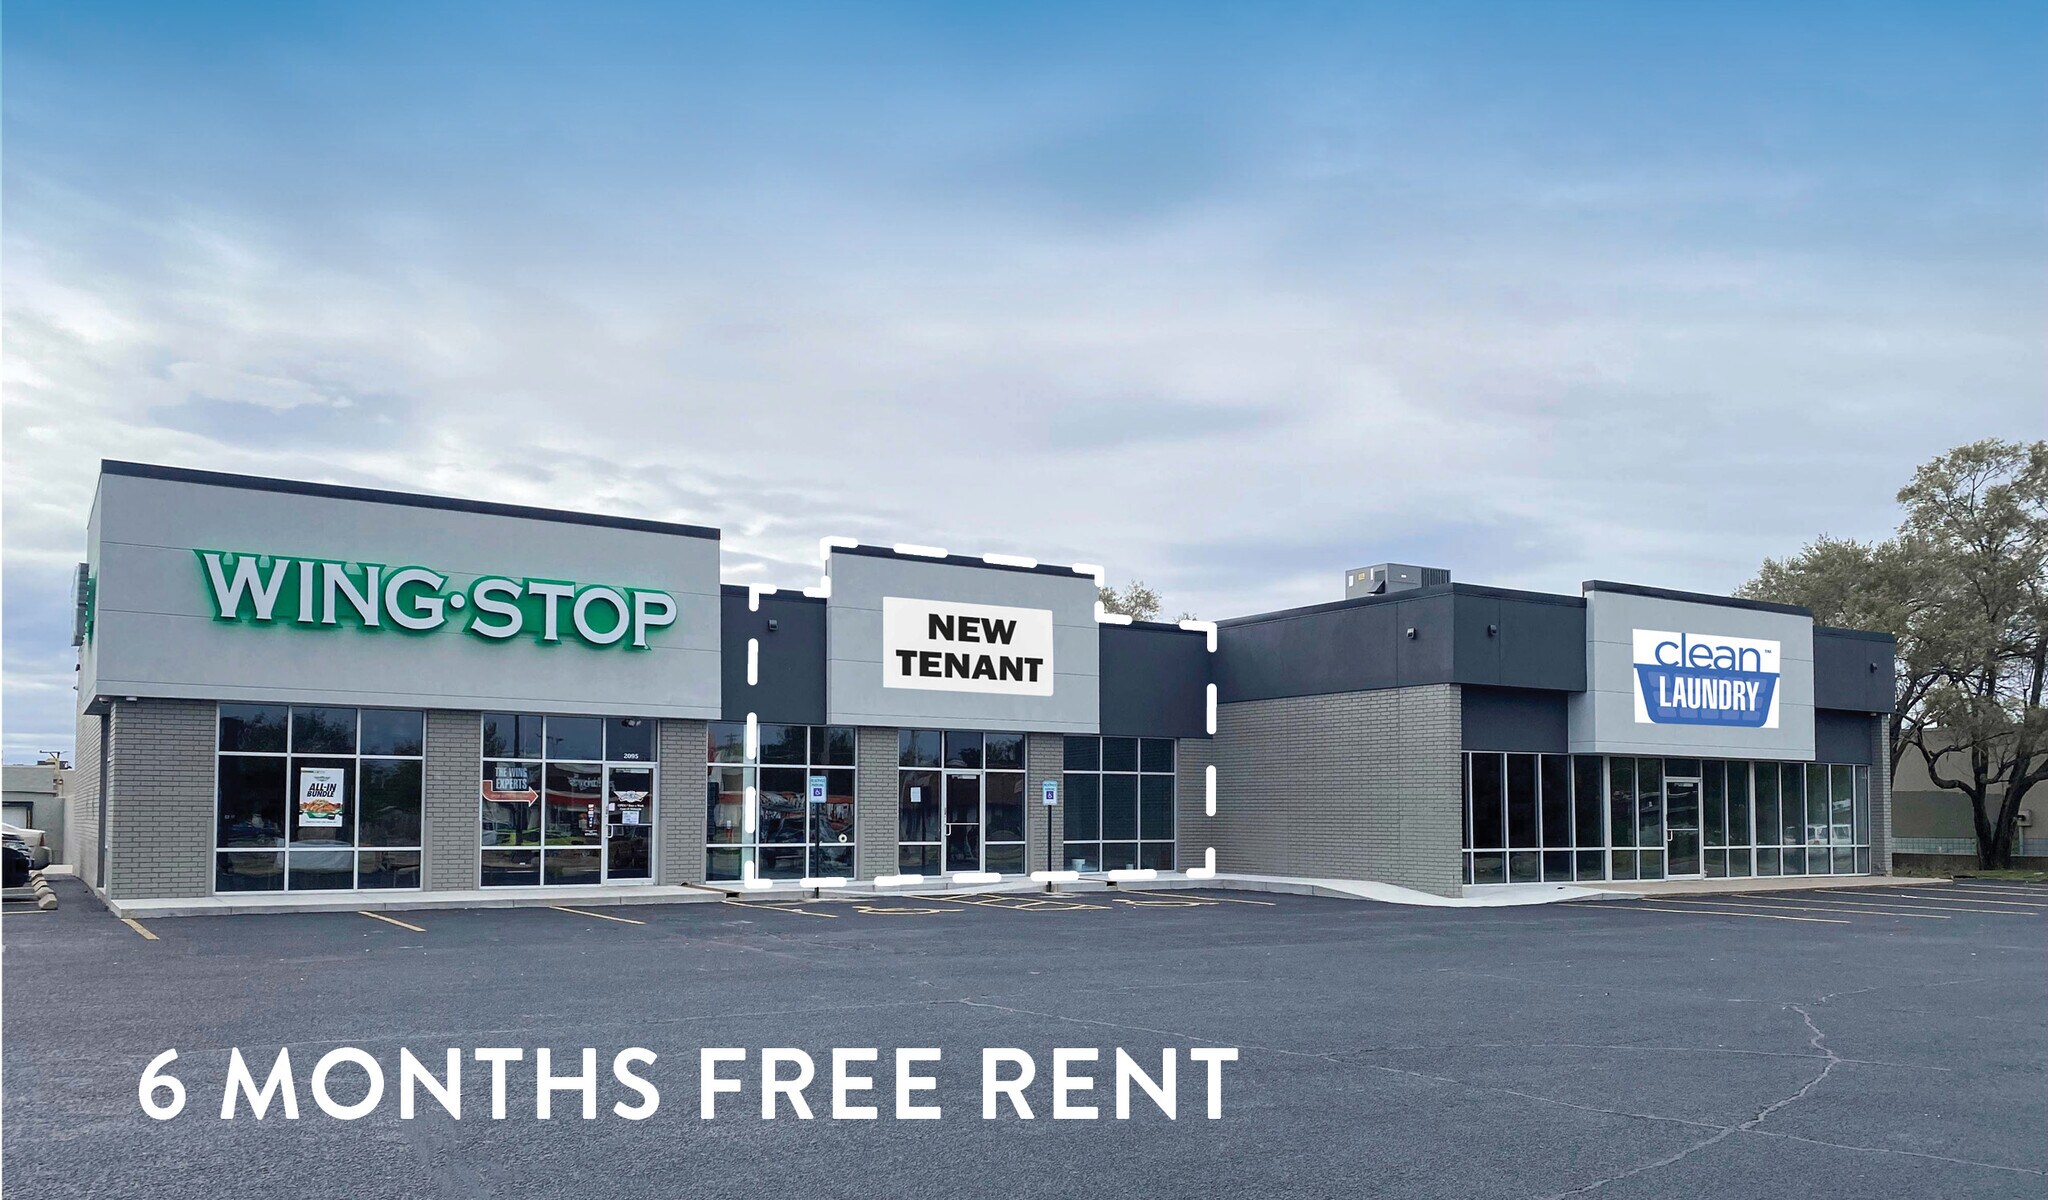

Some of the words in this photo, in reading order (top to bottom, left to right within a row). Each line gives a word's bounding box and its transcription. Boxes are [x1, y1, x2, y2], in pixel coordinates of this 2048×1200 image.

[928, 613, 1017, 645] NEW
[1655, 632, 1761, 672] clean
[895, 649, 1044, 683] TENANT
[1659, 675, 1760, 712] LAUNDRY
[495, 767, 507, 777] THE
[306, 790, 336, 798] BUNDLE
[309, 783, 337, 792] ALL-IN
[495, 777, 528, 790] EXPERTS
